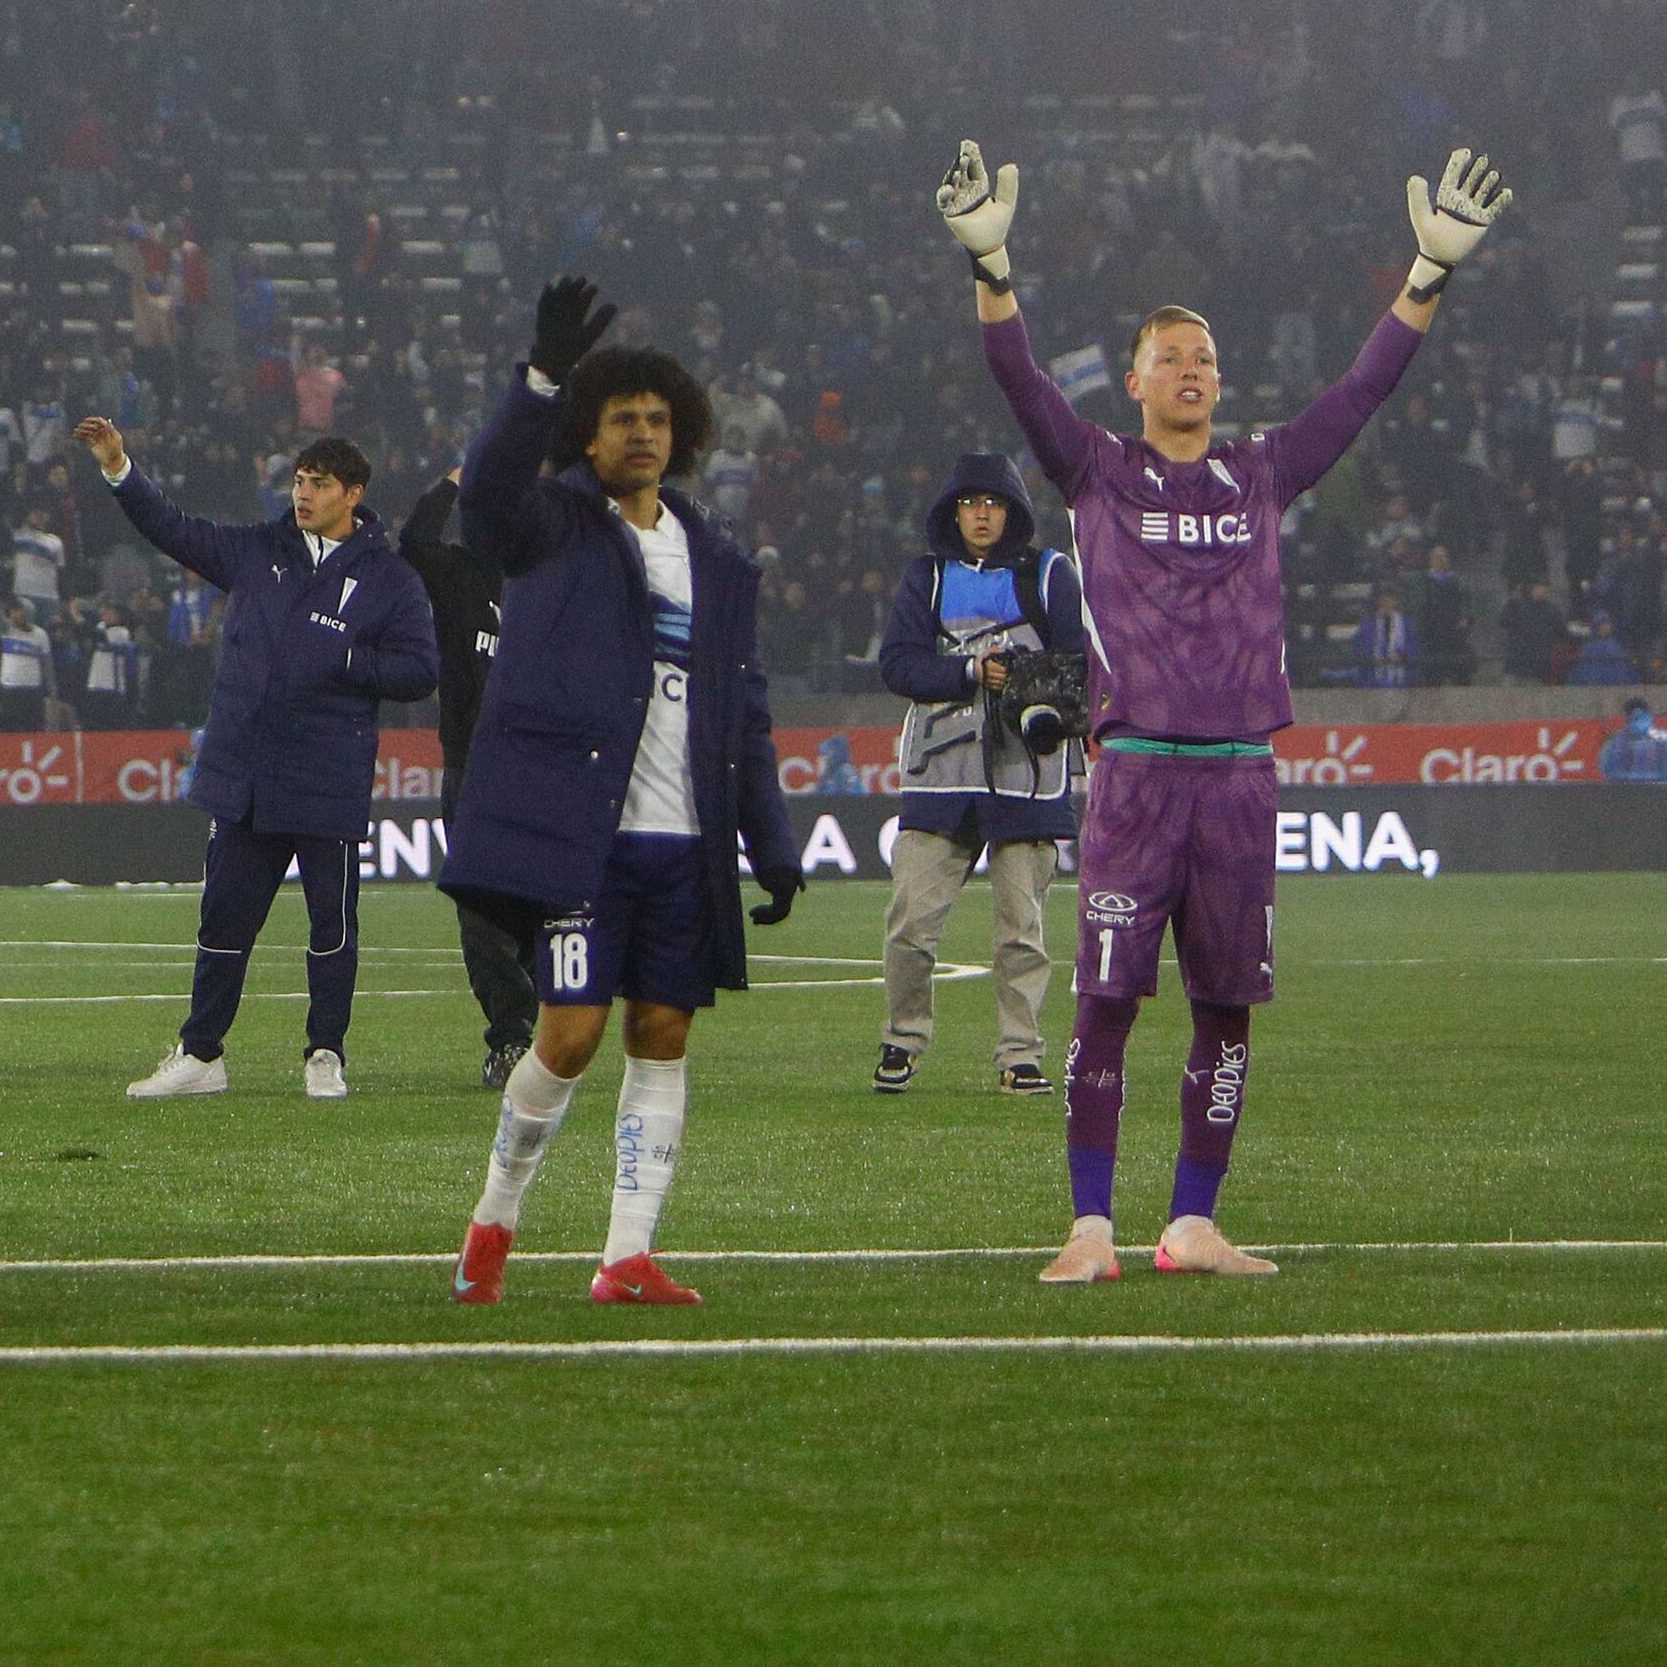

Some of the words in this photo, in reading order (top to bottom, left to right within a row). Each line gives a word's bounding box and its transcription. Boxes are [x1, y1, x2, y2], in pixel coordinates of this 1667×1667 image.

[1178, 513, 1253, 545] BICE
[319, 614, 347, 632] BICE
[1421, 746, 1560, 783] Claro
[543, 917, 594, 930] CHERY
[1085, 910, 1135, 926] CHERY
[549, 932, 588, 990] 18
[1097, 928, 1113, 984] 1
